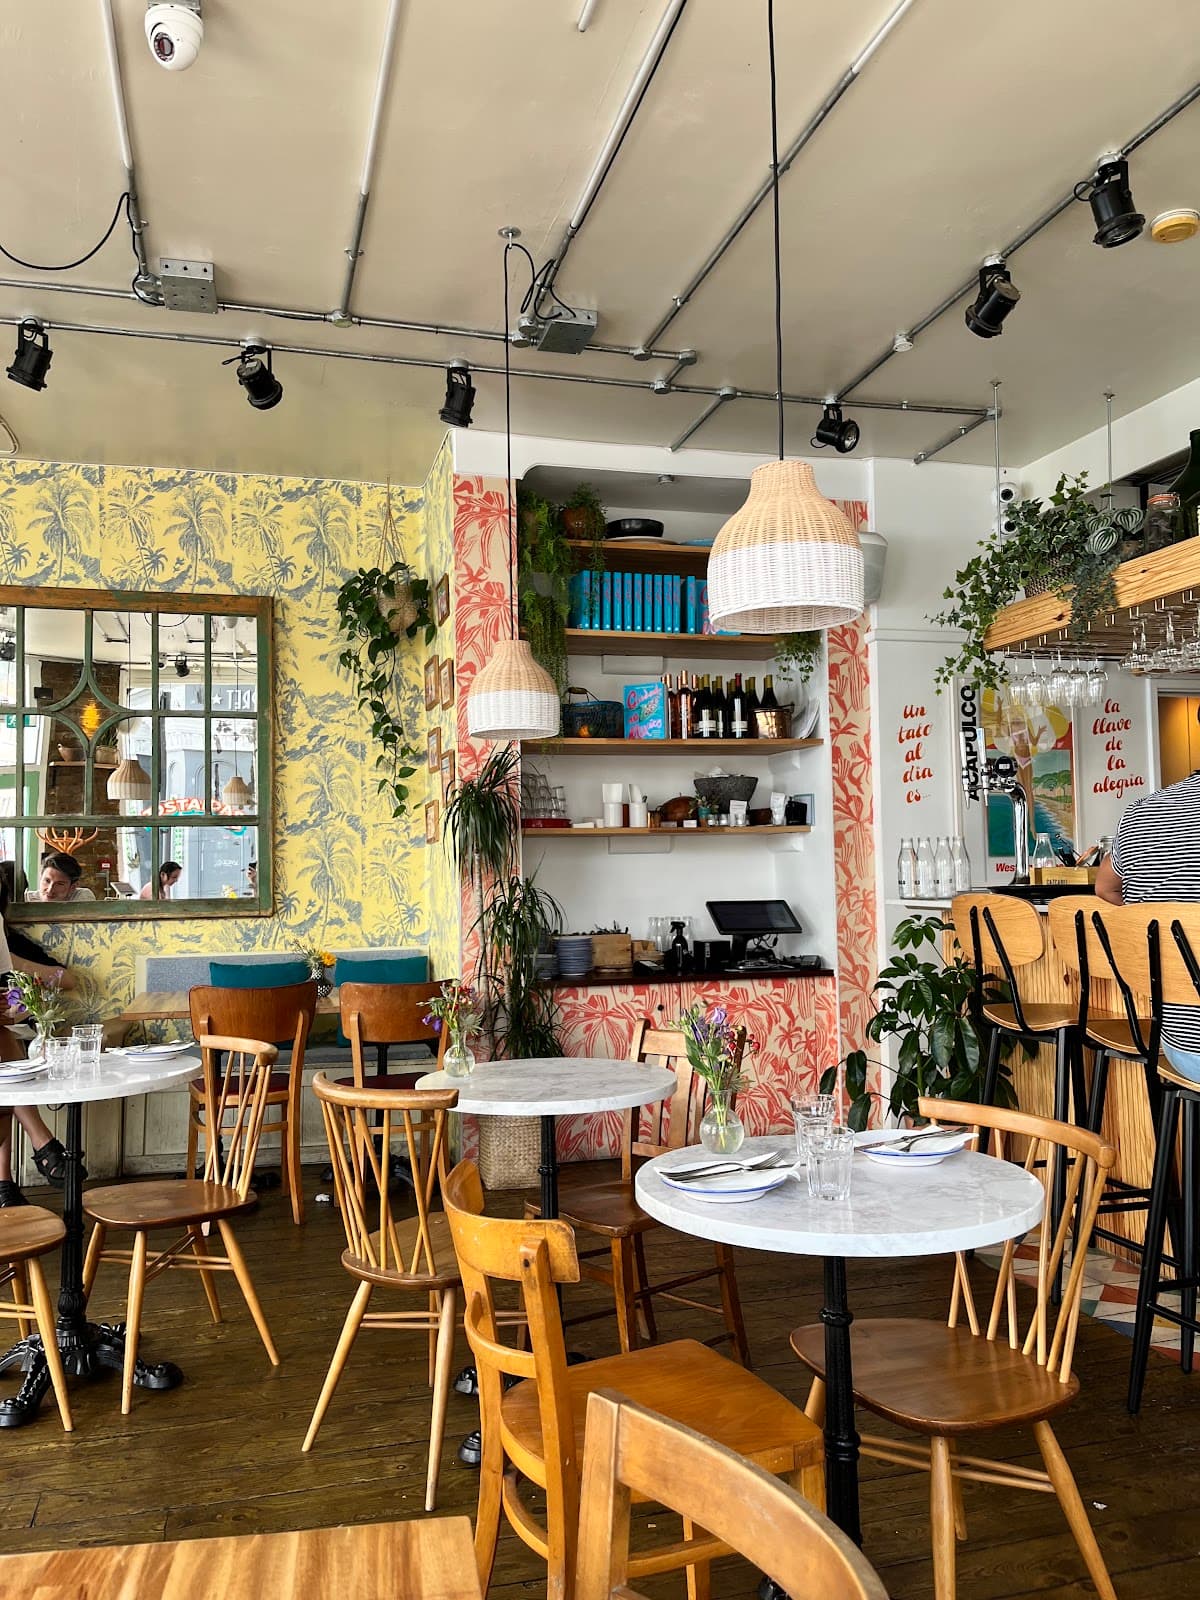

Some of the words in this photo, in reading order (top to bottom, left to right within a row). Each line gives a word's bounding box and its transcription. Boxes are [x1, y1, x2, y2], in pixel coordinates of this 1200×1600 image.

[1105, 698, 1121, 713] la
[898, 723, 933, 744] taco
[1093, 717, 1132, 736] llave
[905, 742, 923, 763] al
[1105, 736, 1123, 751] de
[1107, 754, 1127, 771] la
